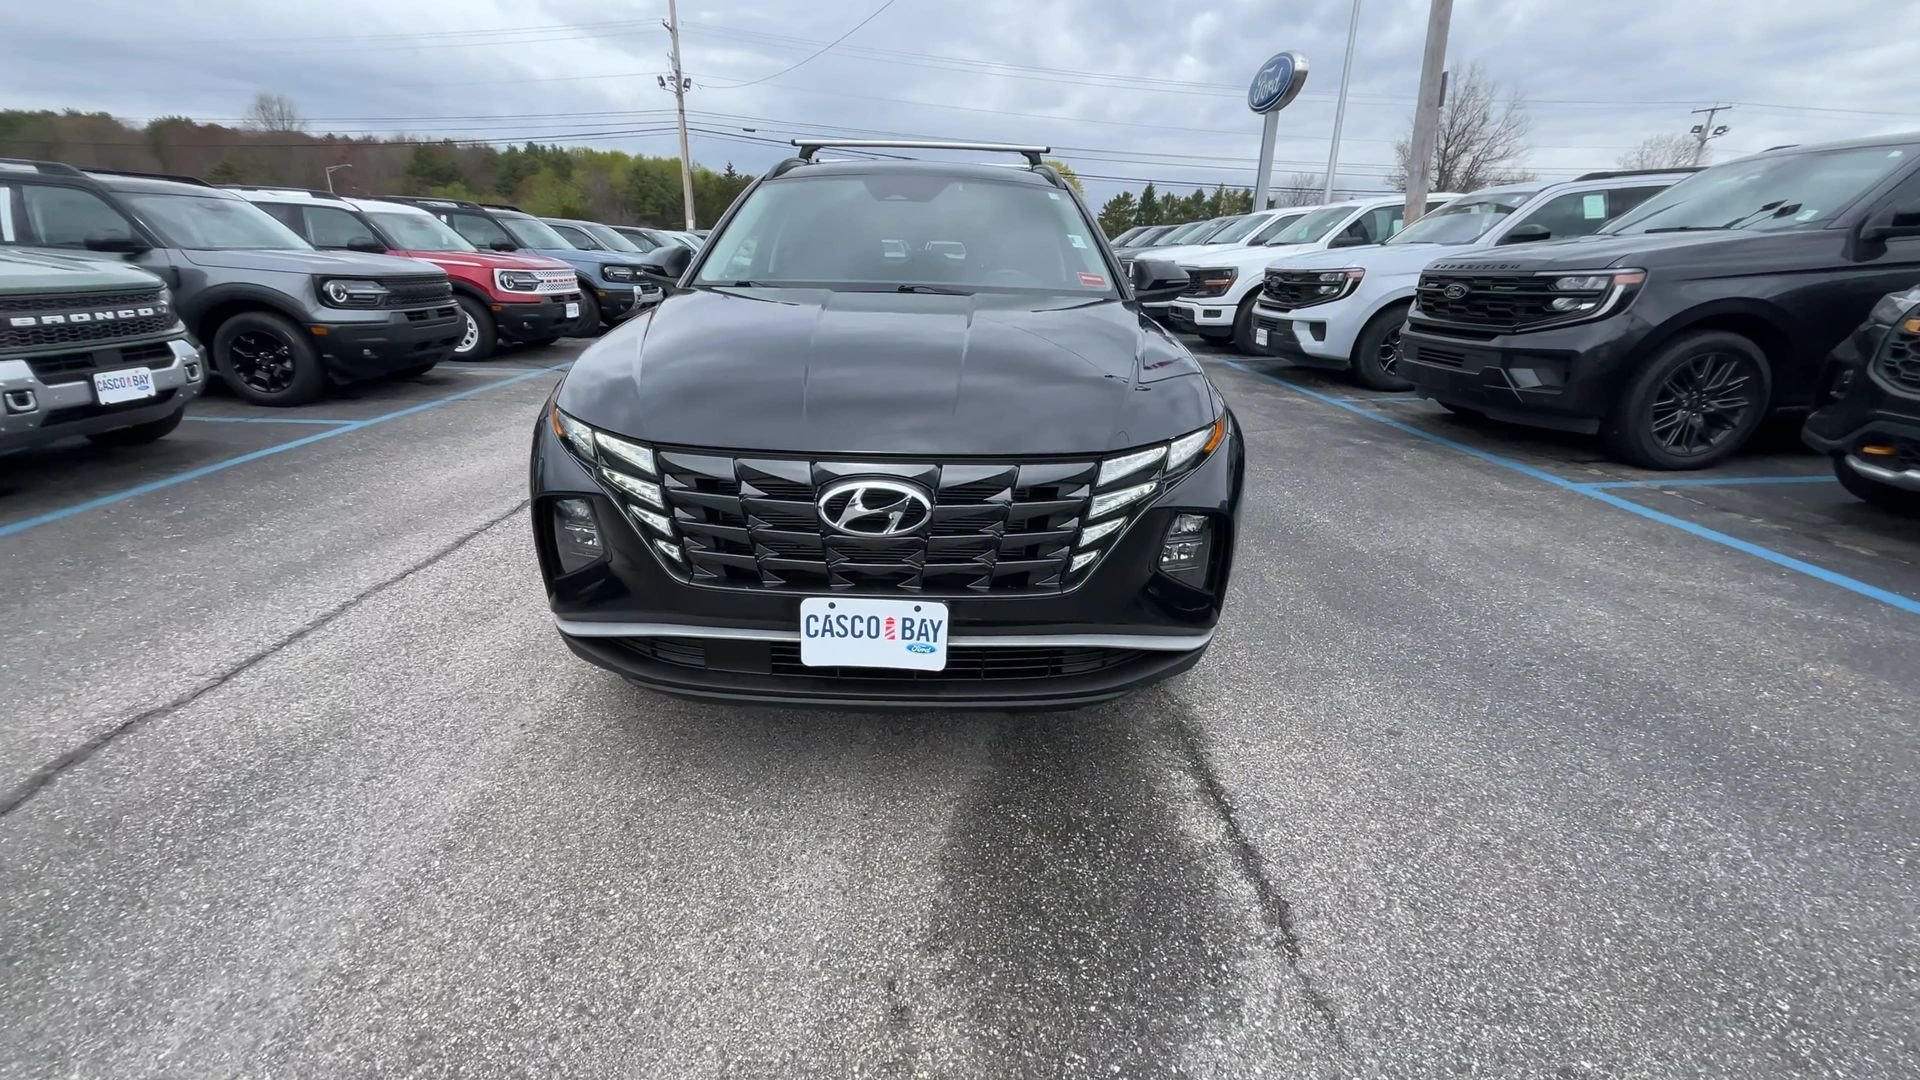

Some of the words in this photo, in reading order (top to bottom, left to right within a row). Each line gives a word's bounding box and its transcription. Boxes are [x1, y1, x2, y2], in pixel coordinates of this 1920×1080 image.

[1254, 64, 1283, 104] Ford
[10, 307, 154, 326] BRONCO
[97, 377, 126, 391] CASCO
[132, 374, 149, 386] BAY
[805, 614, 880, 639] CASCO
[902, 617, 943, 643] BAY
